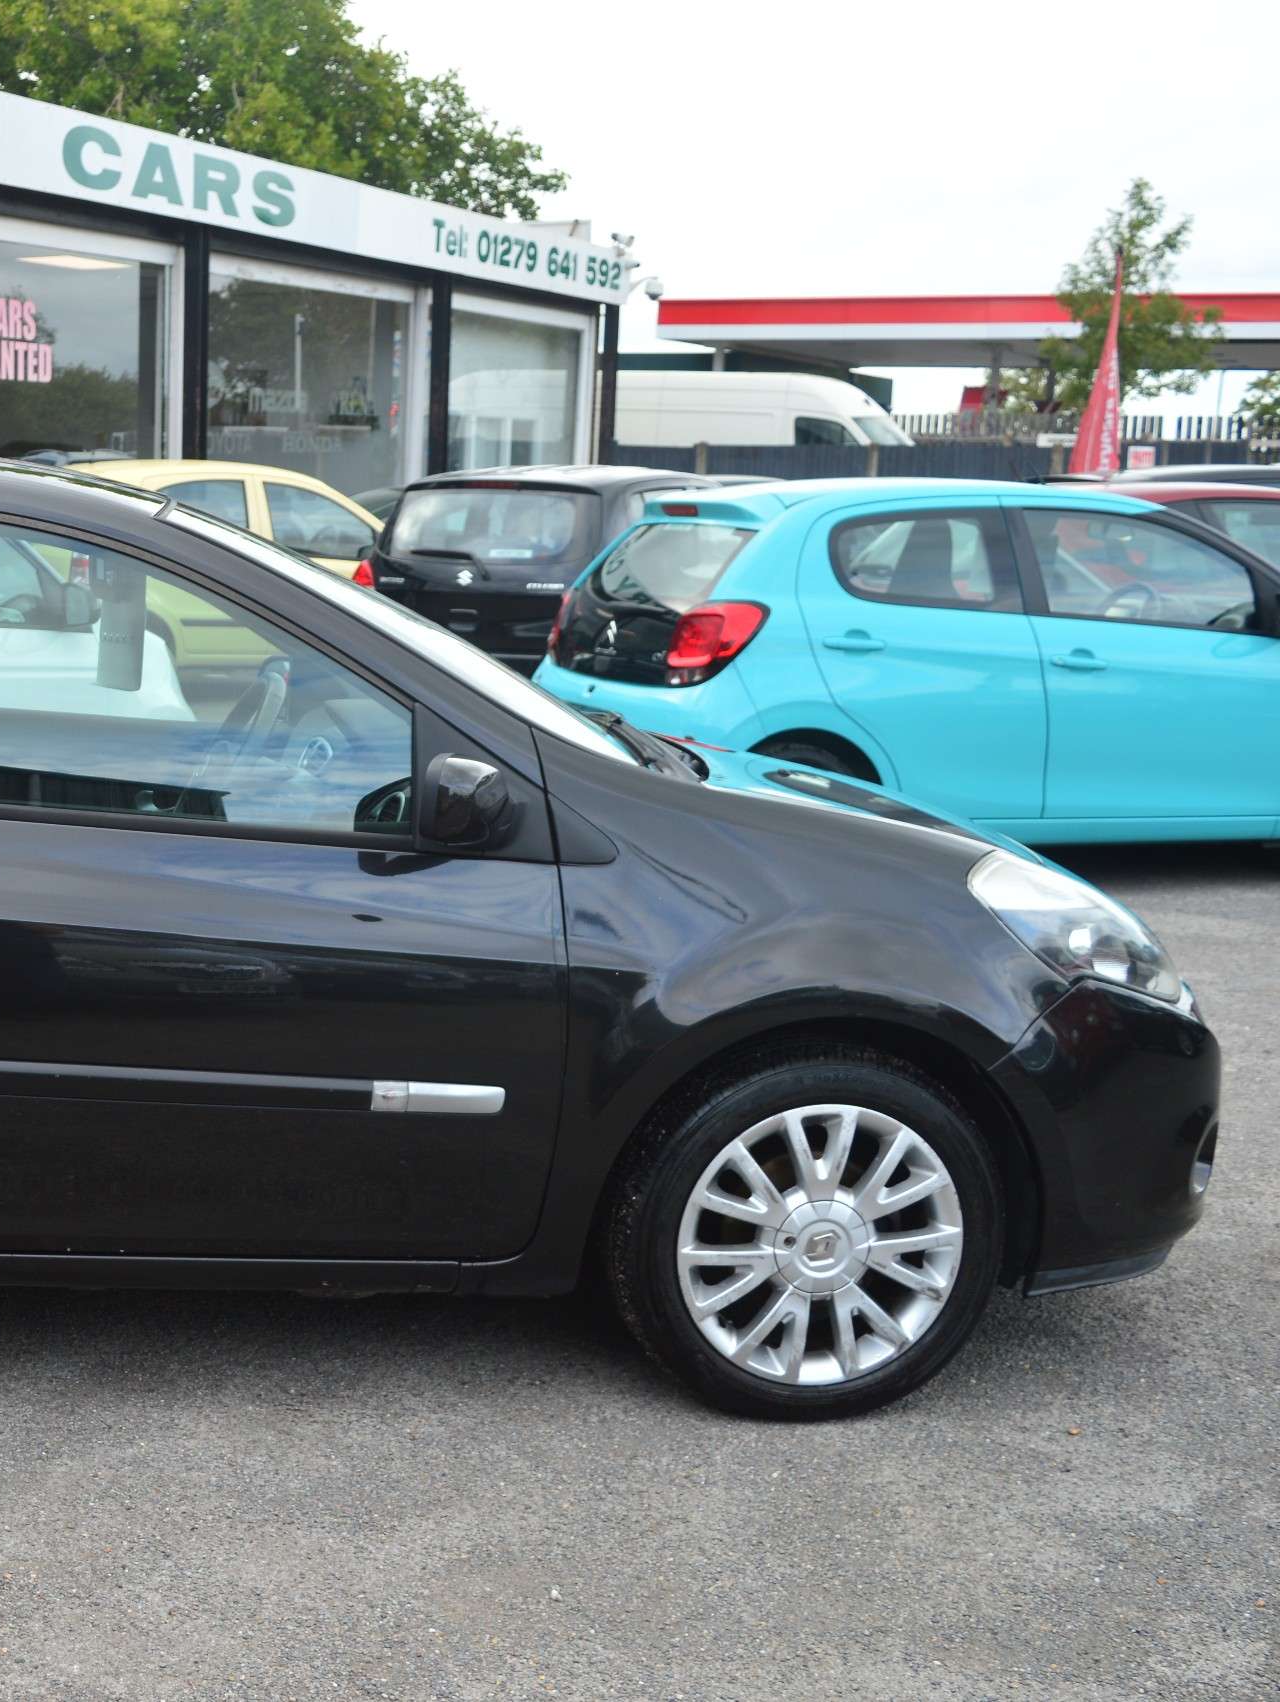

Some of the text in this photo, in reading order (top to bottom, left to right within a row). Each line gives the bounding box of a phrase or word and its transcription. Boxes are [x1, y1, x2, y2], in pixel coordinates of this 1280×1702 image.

[62, 125, 296, 227] CARS
[432, 217, 622, 291] Tel: 01279 641 592
